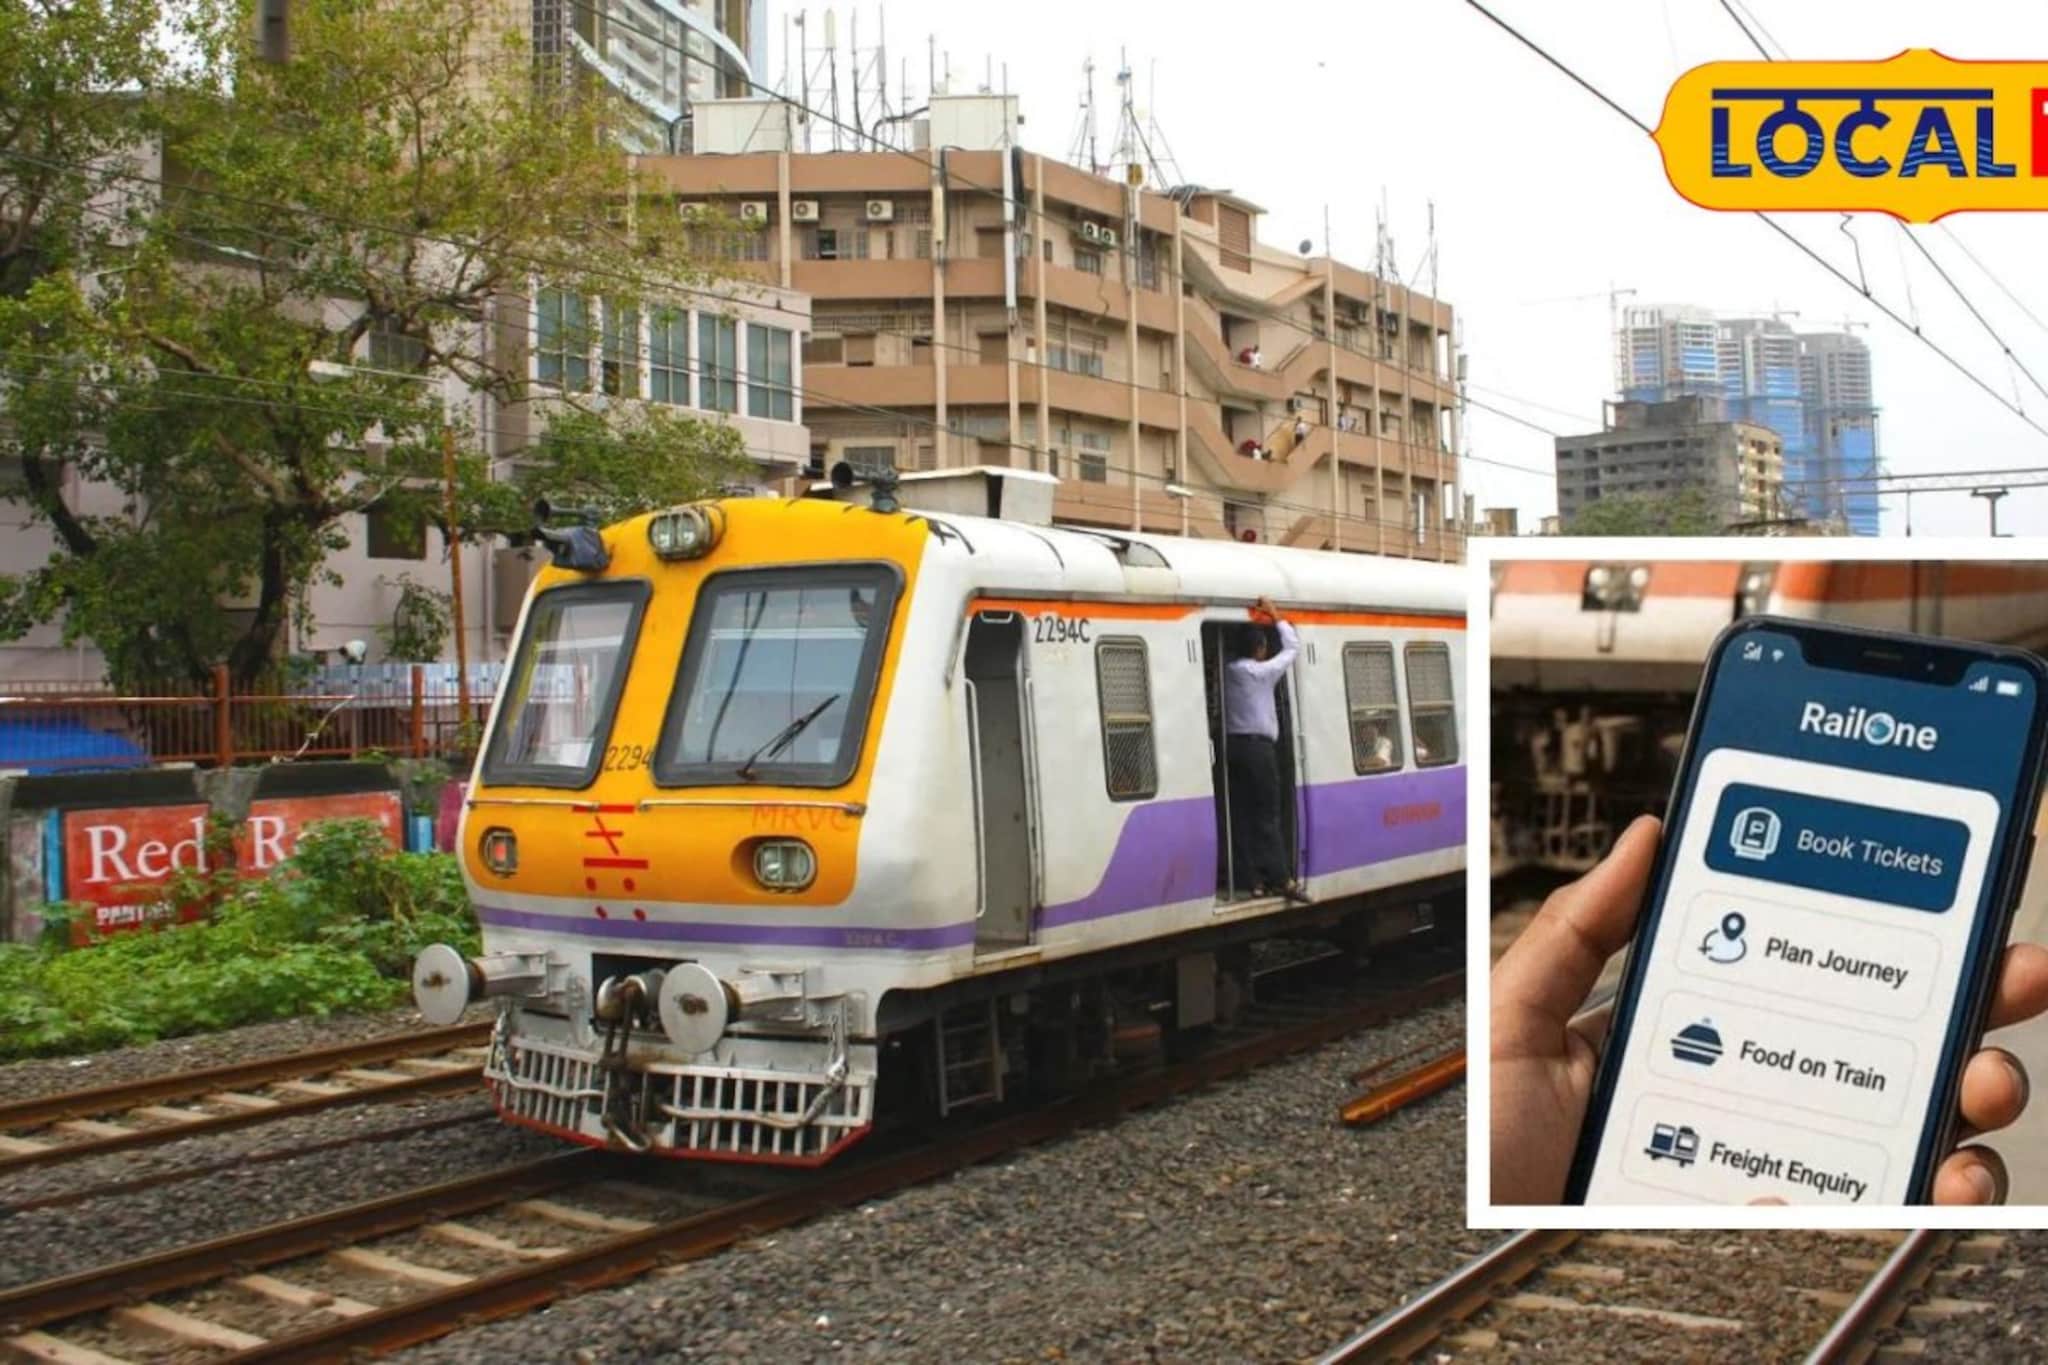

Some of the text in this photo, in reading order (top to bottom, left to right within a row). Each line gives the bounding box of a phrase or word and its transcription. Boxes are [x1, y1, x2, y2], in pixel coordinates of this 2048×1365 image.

[1034, 615, 1091, 644] 2294C
[1799, 701, 1938, 751] RailOne
[604, 744, 652, 772] 2294
[83, 816, 209, 884] Red
[1797, 829, 1944, 877] Book Tickets
[1764, 937, 1909, 990] Plan Journey
[1740, 1041, 1887, 1092] Food on Train
[1710, 1142, 1868, 1202] Freight Enquiry
